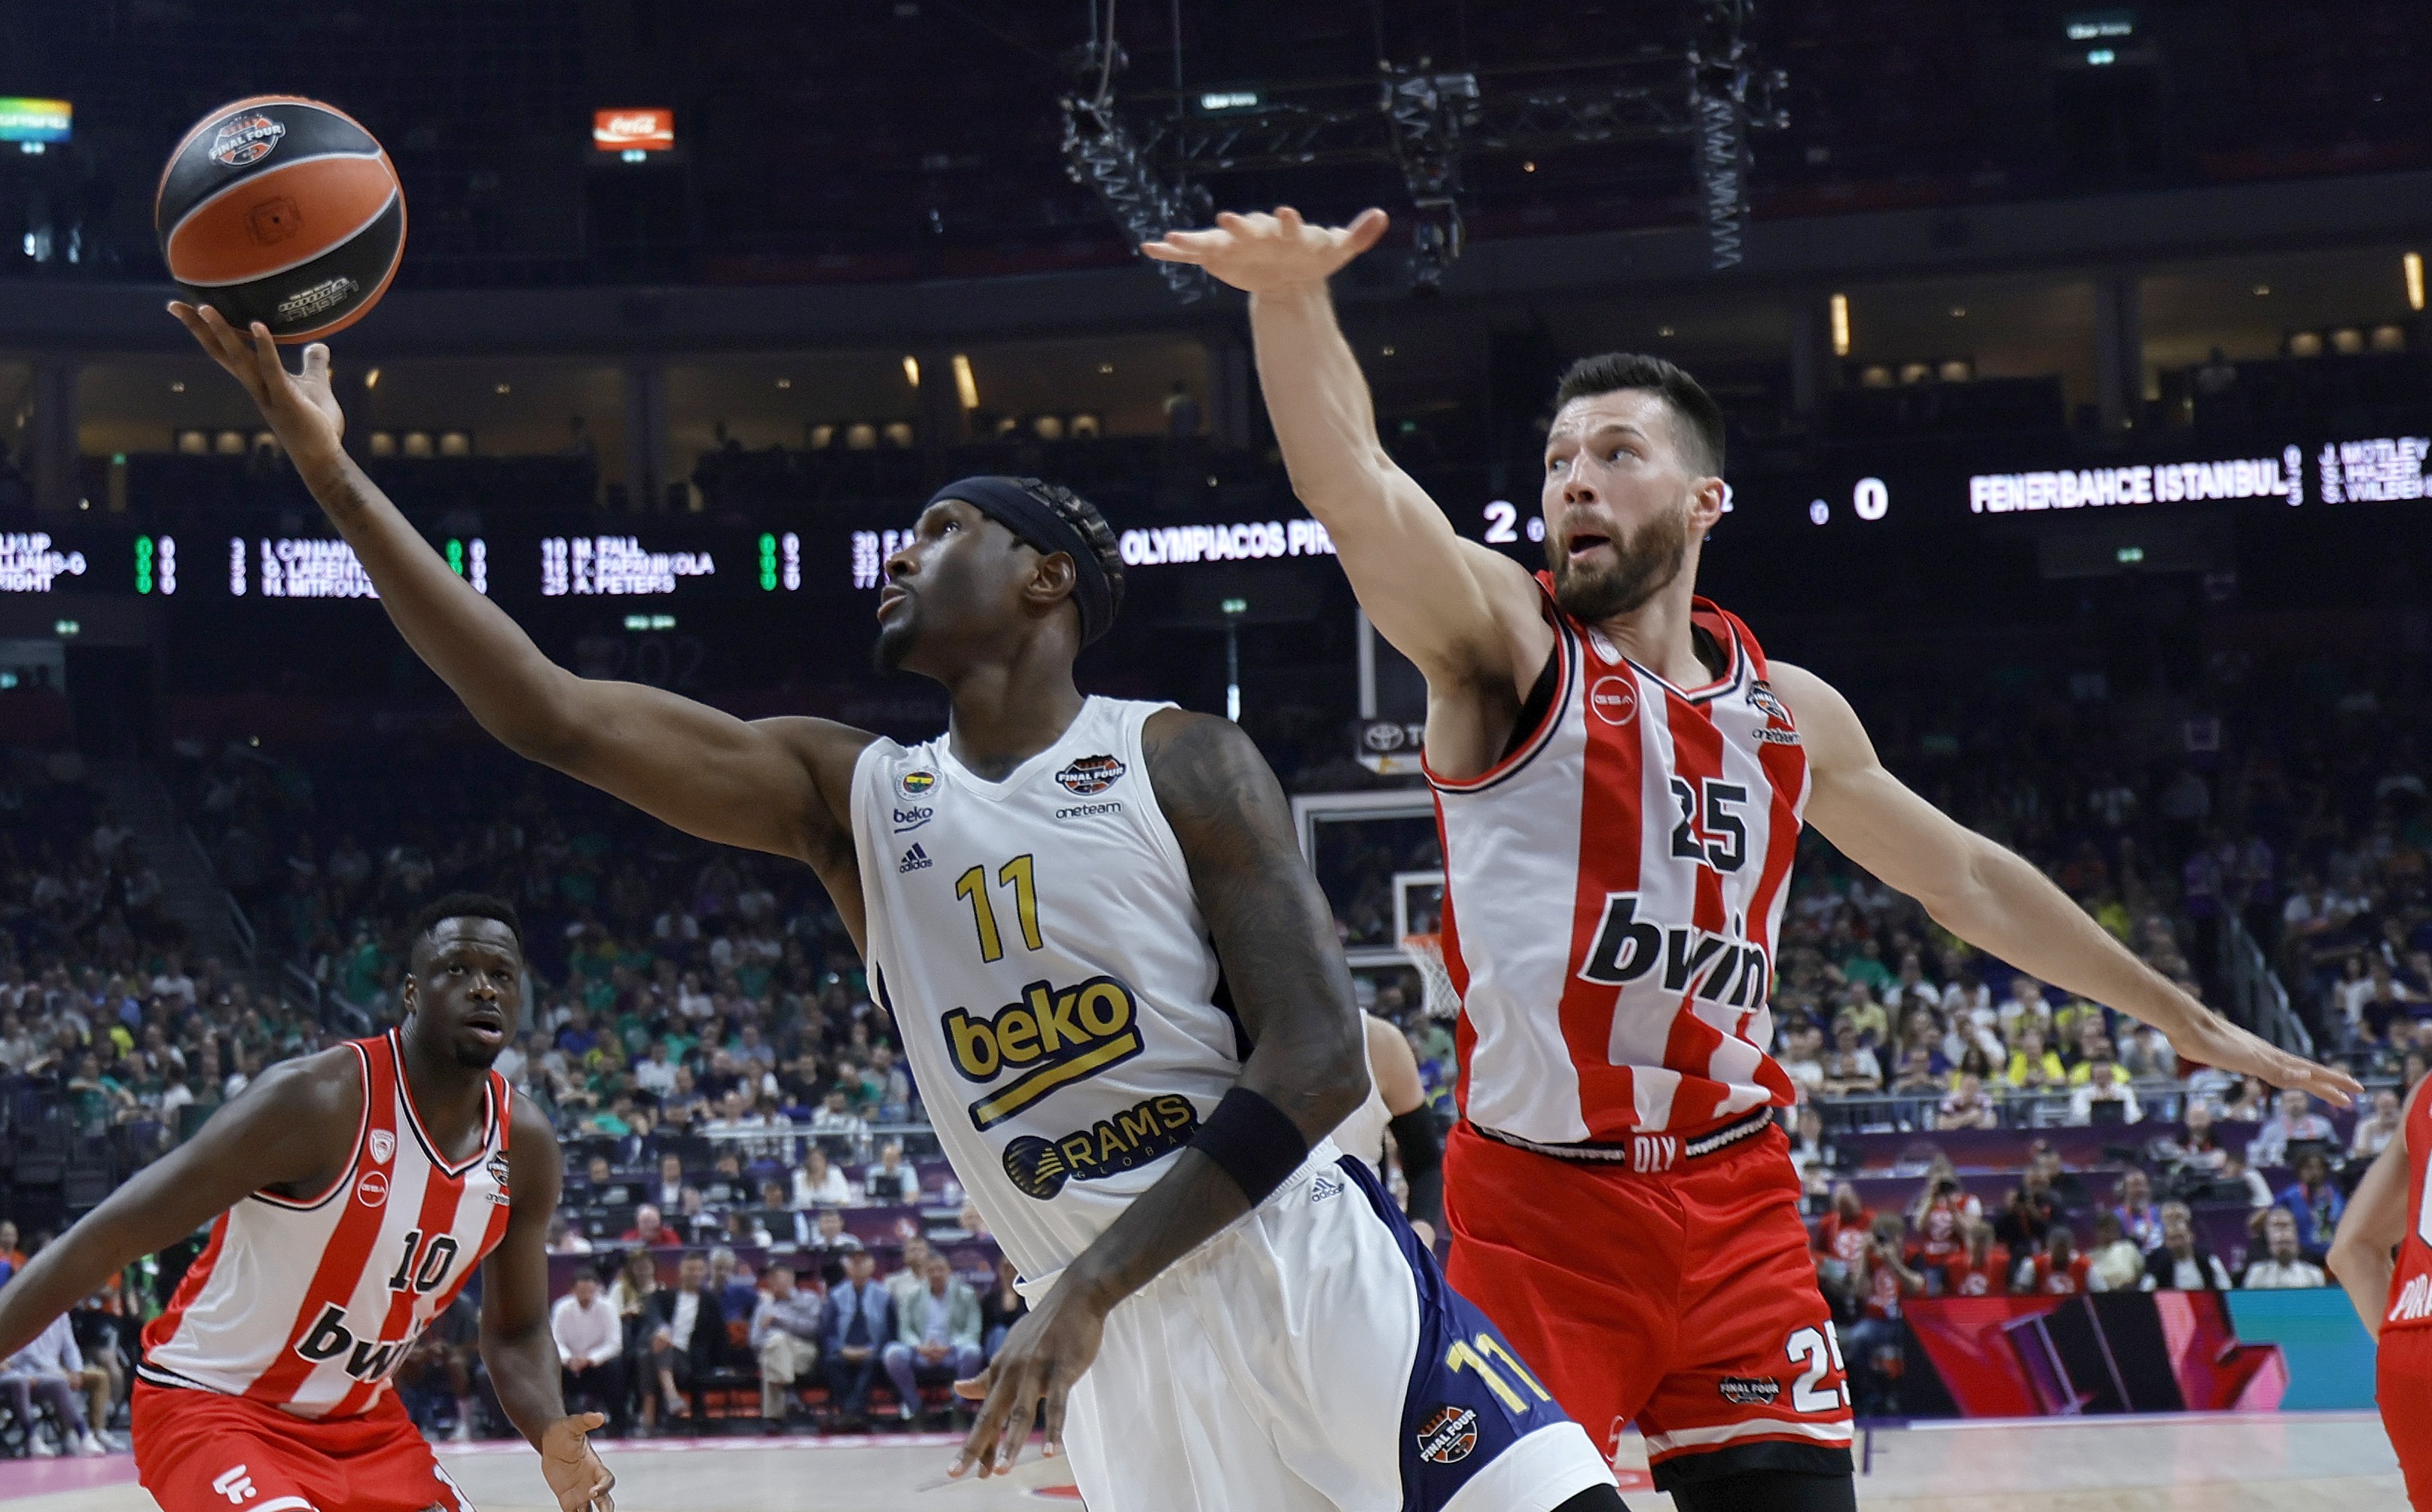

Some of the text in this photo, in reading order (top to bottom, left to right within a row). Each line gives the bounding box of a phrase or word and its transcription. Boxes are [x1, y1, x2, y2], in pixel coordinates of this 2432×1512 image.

[210, 136, 245, 160] FINAL
[246, 123, 282, 142] FOUR
[1854, 477, 1889, 520] 0
[1969, 458, 2289, 514] FENERBAHCE ISTANBUL
[1119, 521, 1287, 565] OLYMPIACOS
[1485, 501, 1518, 543] 2
[595, 535, 645, 557] FALL
[595, 574, 676, 593] PETERS
[1058, 766, 1124, 782] FINAL FOUR
[893, 806, 933, 823] beko
[1055, 802, 1121, 819] oneteam
[1668, 776, 1749, 875] 25
[899, 859, 933, 873] adidas
[955, 852, 1044, 963] 11
[1578, 893, 1768, 1013] bwin
[945, 979, 1133, 1078] beko
[1061, 1096, 1191, 1169] RAMS
[388, 1228, 460, 1295] 10
[1446, 1332, 1553, 1415] 11
[1719, 1382, 1780, 1395] FINAL FOUR
[1420, 1430, 1451, 1463] FINAL
[1446, 1409, 1477, 1437] FOUR
